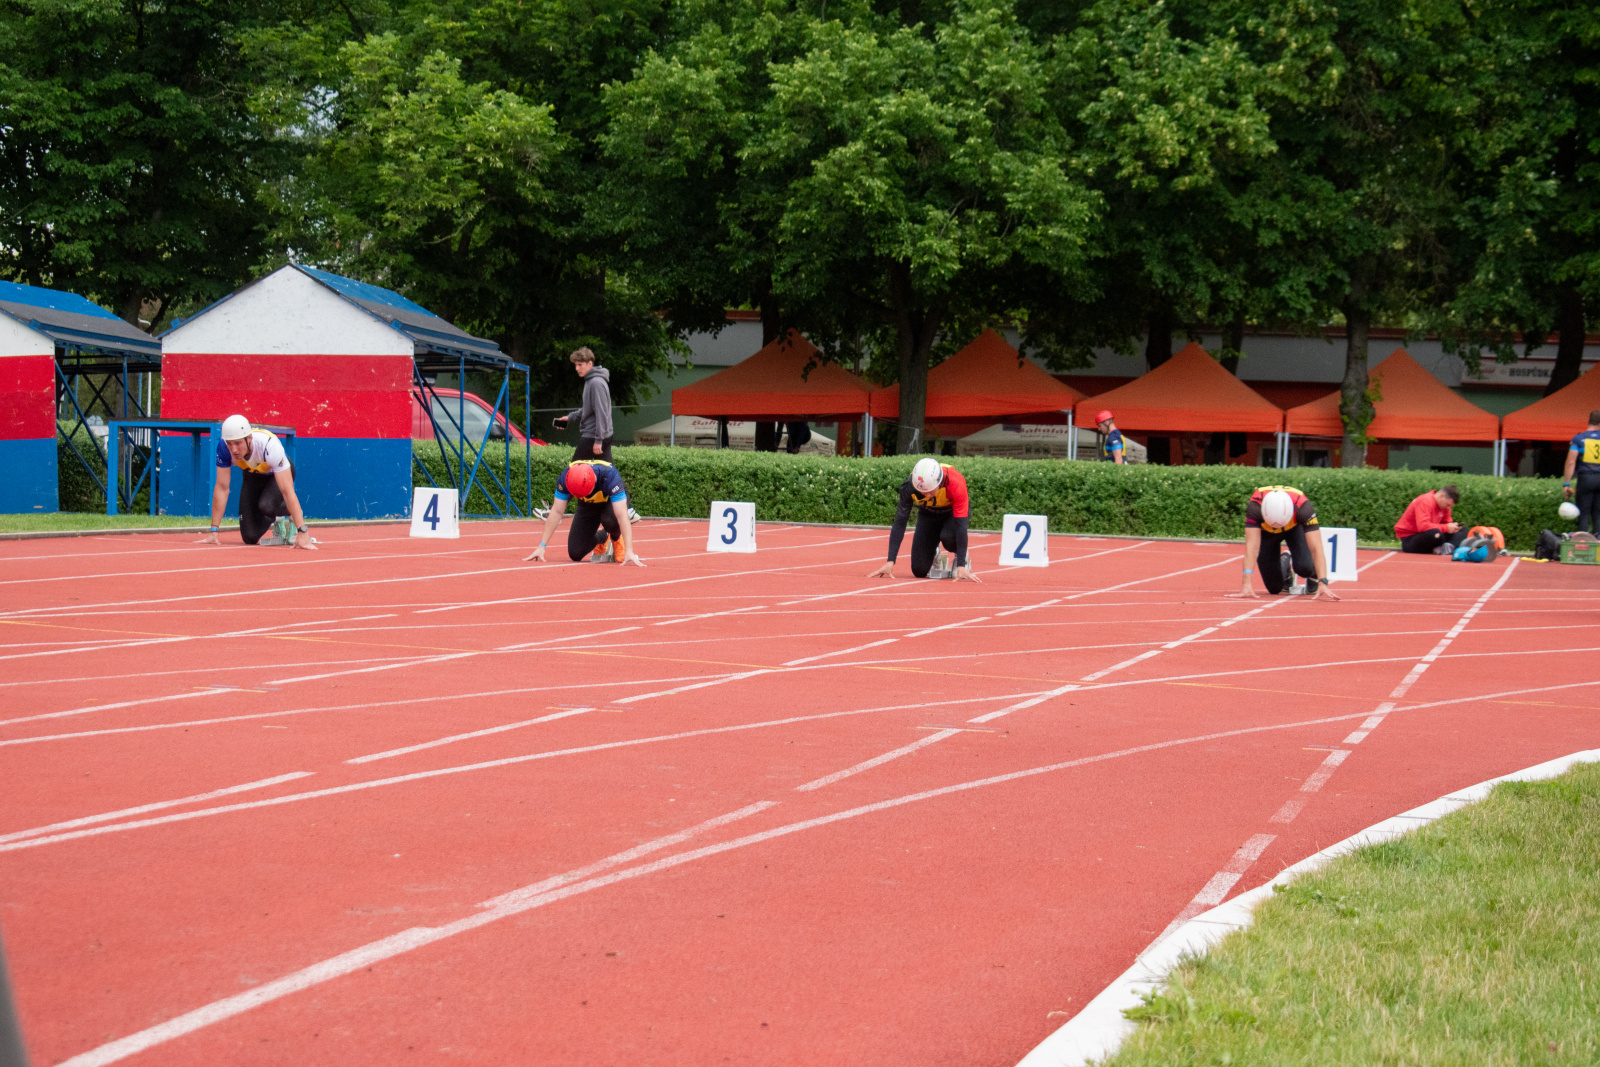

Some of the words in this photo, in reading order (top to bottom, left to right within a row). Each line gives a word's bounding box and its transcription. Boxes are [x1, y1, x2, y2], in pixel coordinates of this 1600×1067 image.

[423, 493, 440, 531] 4
[721, 507, 738, 545] 3
[1013, 520, 1032, 559] 2
[1327, 533, 1338, 573] 1
